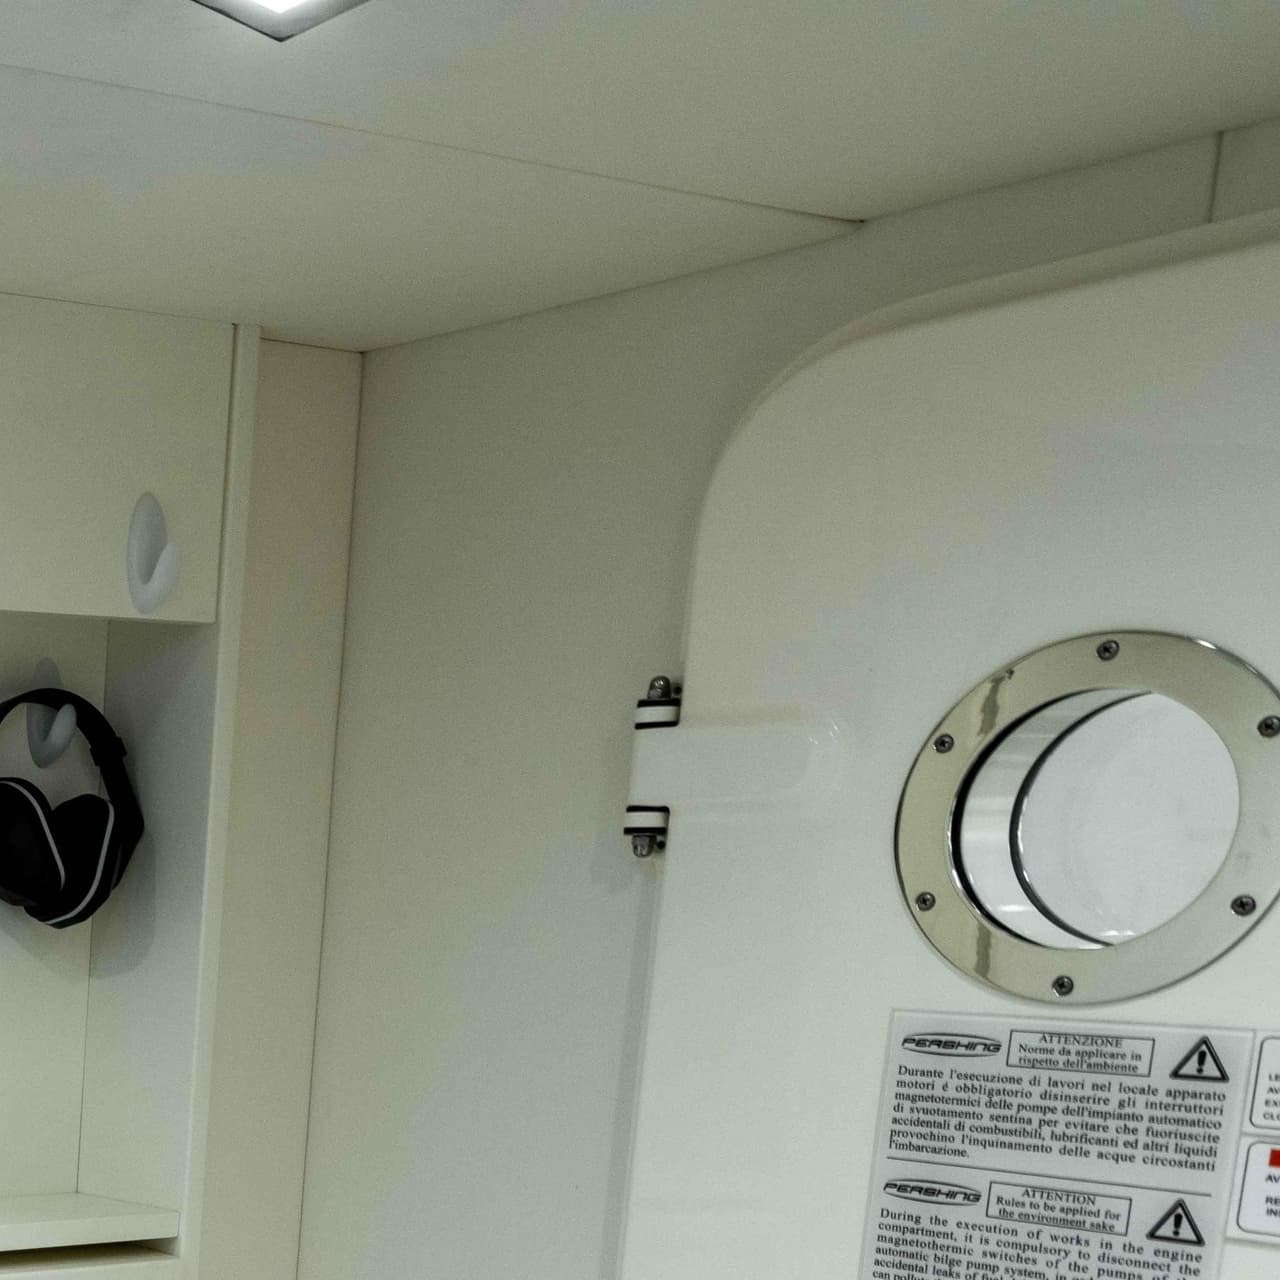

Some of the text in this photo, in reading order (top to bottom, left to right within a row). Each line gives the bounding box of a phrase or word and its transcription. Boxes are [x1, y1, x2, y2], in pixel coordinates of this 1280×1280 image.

[900, 1034, 1002, 1054] PERSHING
[1017, 1043, 1143, 1064] Norme da applicare in
[1038, 1033, 1123, 1048] ATTENZIONE
[1017, 1054, 1139, 1073] rispetto dell'ambiente
[895, 1076, 935, 1090] motori
[954, 1082, 1033, 1102] obbligatorio
[1038, 1089, 1111, 1106] disinserire
[1117, 1096, 1137, 1111] gli
[1143, 1098, 1224, 1116] interruttori
[897, 1064, 1227, 1106] Durante l'esecuzione di lavori nel locale apparato
[892, 1101, 1220, 1144] di svuotamento sentina per evitare che fuoriuscite
[893, 1089, 1223, 1130] magnetotermici delle pompe dell'impianto automatico
[888, 1126, 1216, 1172] provochino l'inquinamento delle acque circostanti
[890, 1113, 1218, 1161] accidentali di combustibili, lubrificanti ed altri liquidi
[882, 1180, 981, 1204] PERSHING
[1020, 1187, 1097, 1206] ATTENTION
[995, 1195, 1122, 1221] Rules to be applied for
[997, 1206, 1116, 1232] the environment sake
[877, 1219, 1201, 1277] compartment, it is compulsory to disconnect the
[879, 1207, 1203, 1267] During the execution of works in the engine
[873, 1255, 928, 1274] accidental
[931, 1265, 961, 1279] leaks
[874, 1243, 930, 1262] automatic
[932, 1252, 963, 1270] bilge
[964, 1260, 1000, 1276] pump
[876, 1231, 974, 1259] magnetothermic
[981, 1247, 1038, 1266] switches
[1044, 1257, 1059, 1269] of
[1067, 1260, 1089, 1274] the
[871, 1270, 891, 1280] can
